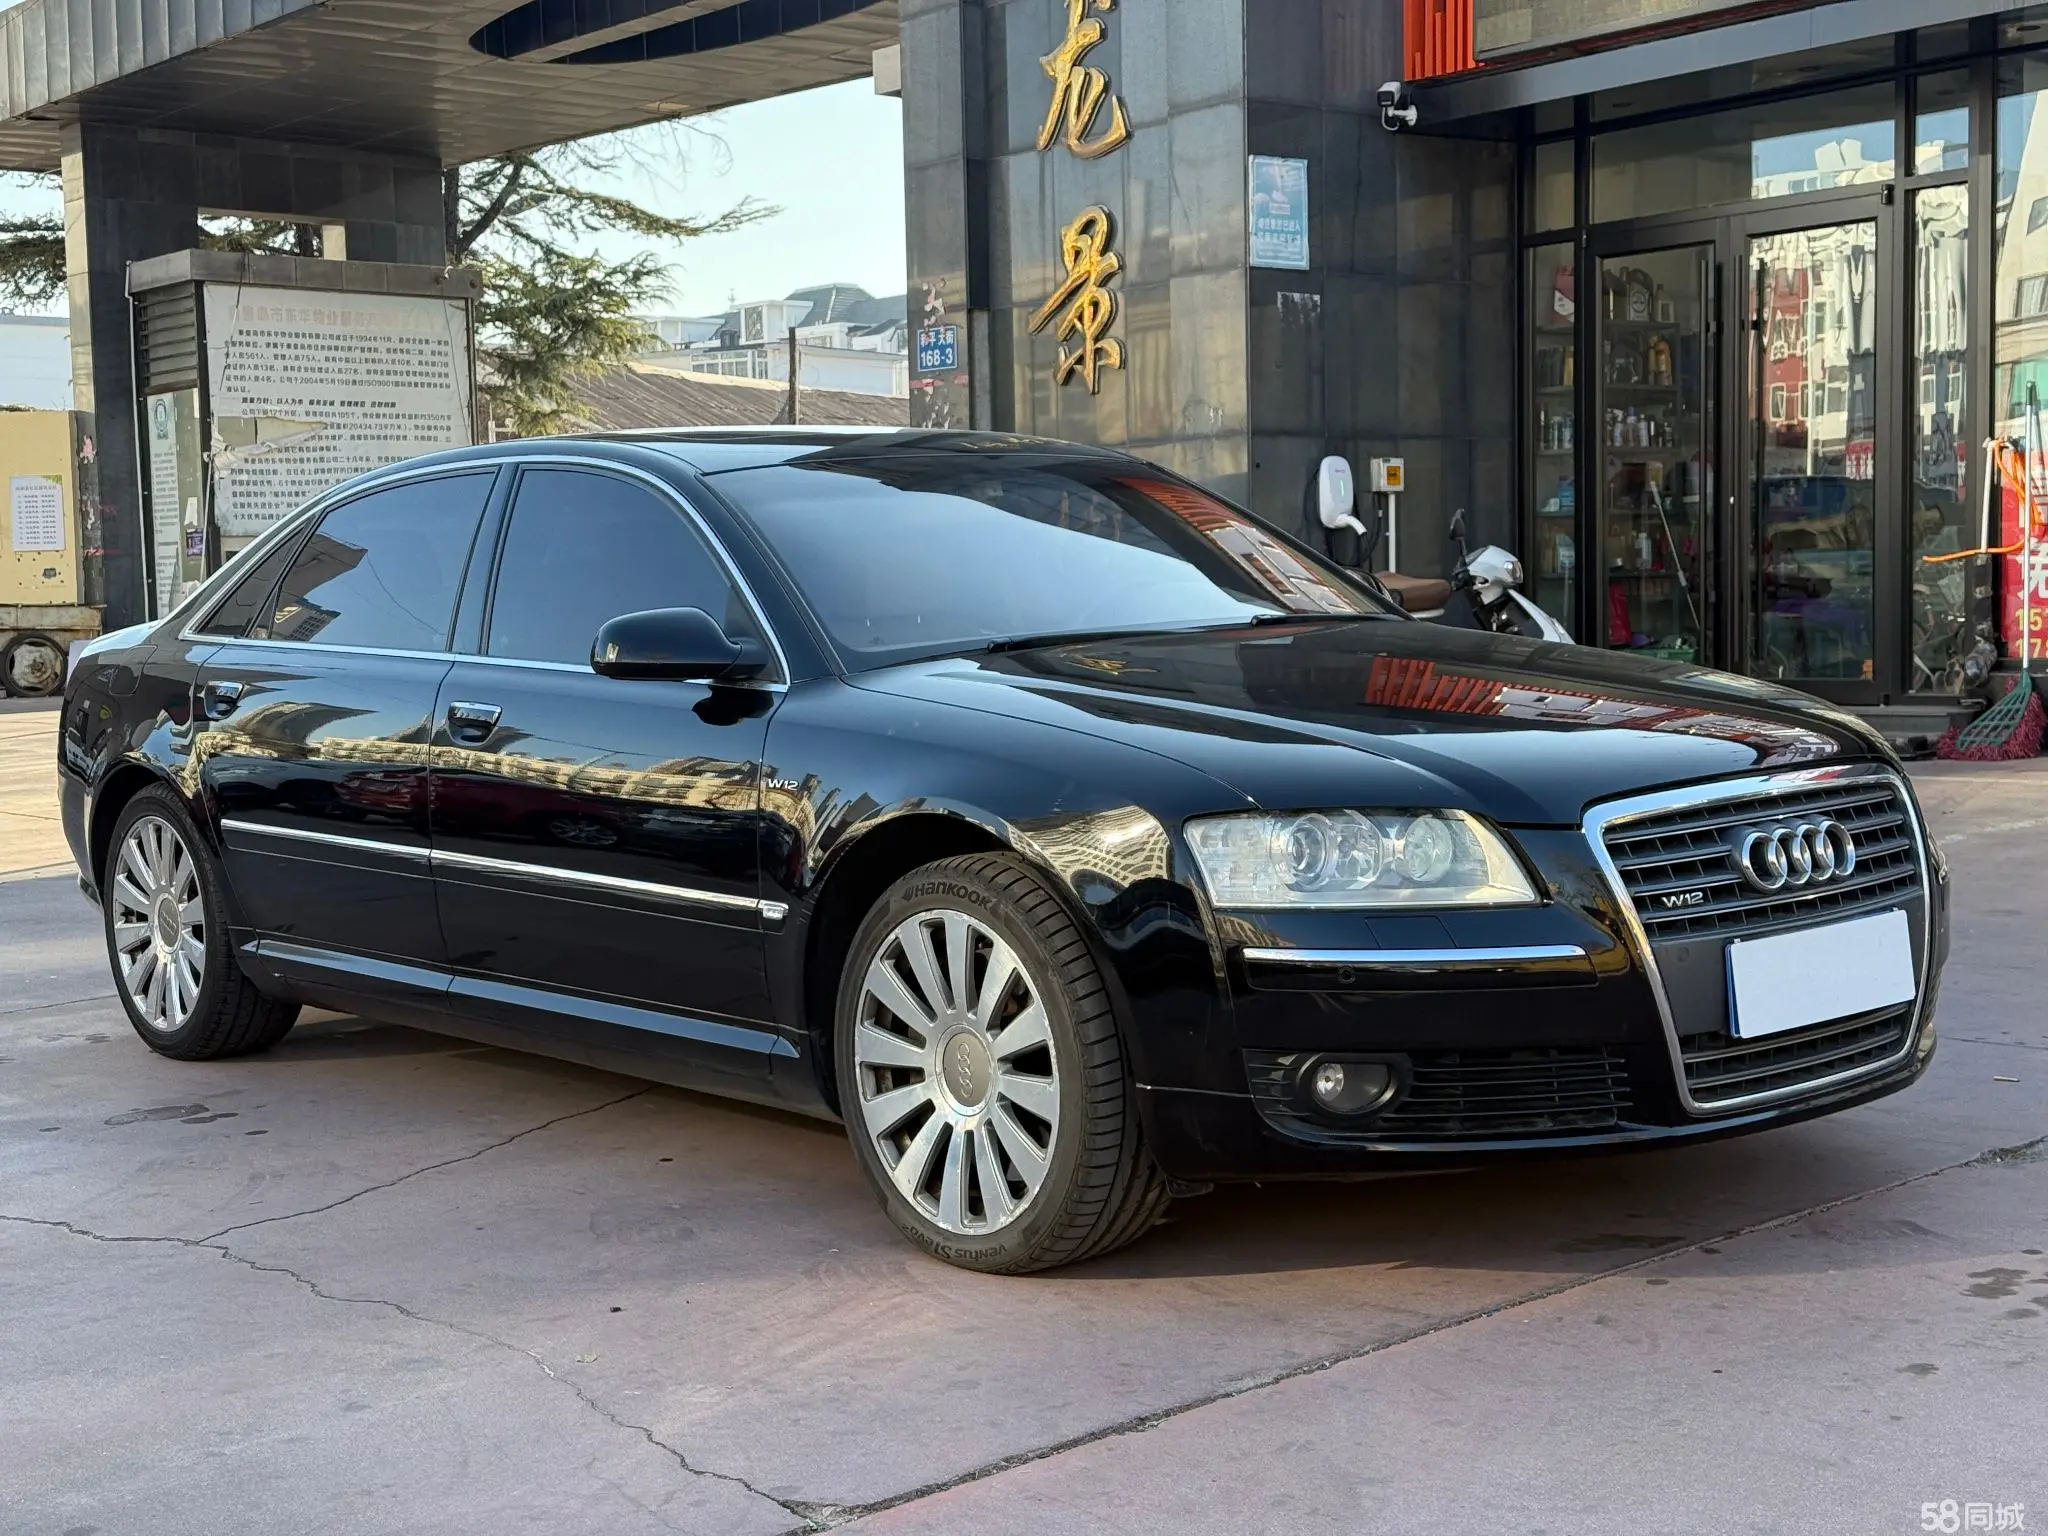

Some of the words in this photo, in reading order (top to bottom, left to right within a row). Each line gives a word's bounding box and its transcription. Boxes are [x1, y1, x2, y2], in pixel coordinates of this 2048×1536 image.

[920, 348, 954, 367] 168-3
[2015, 607, 2048, 632] 15
[2015, 638, 2048, 659] 17
[768, 779, 799, 791] W12
[1661, 892, 1704, 908] W12
